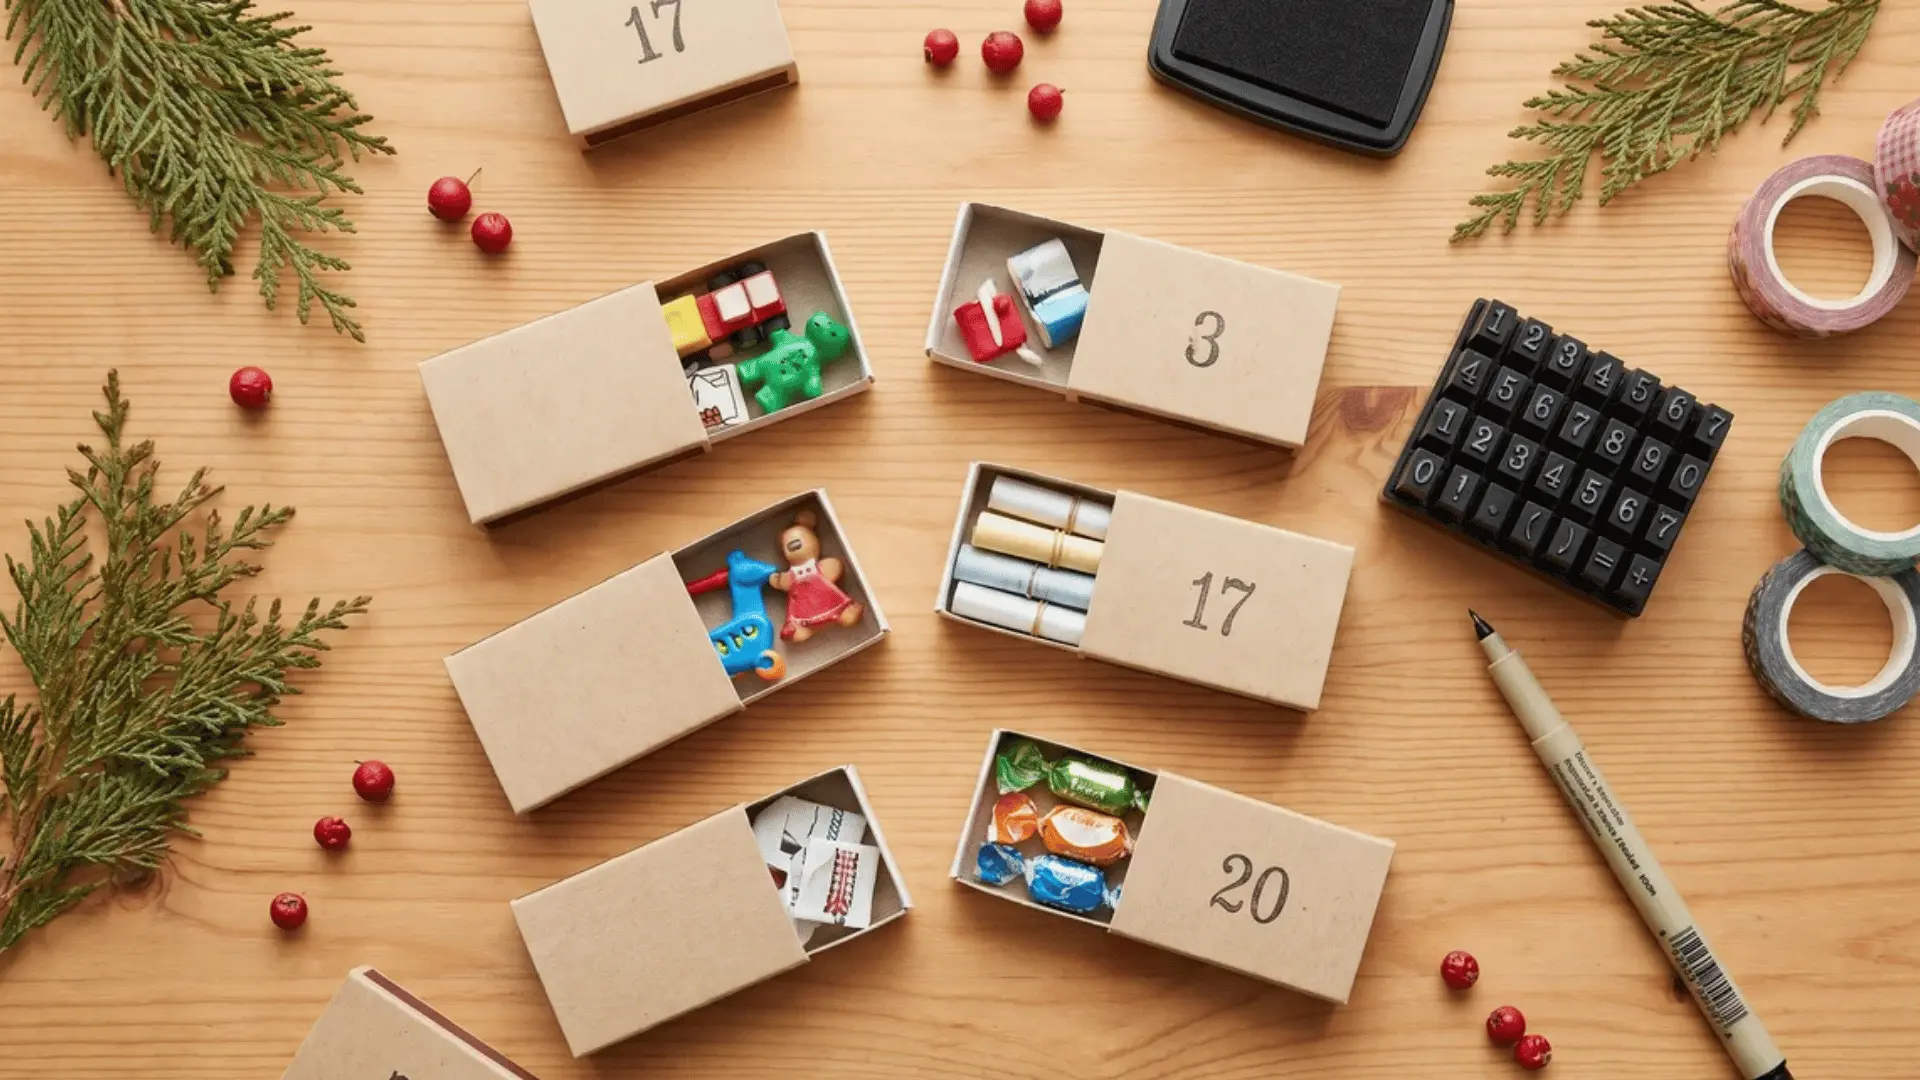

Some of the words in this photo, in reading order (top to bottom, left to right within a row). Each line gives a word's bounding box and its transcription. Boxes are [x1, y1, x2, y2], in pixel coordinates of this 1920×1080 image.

[625, 0, 685, 64] 17
[1185, 310, 1225, 368] 3
[1489, 308, 1506, 334] 1
[1522, 326, 1544, 351] 2
[1558, 341, 1578, 368] 3
[1594, 361, 1613, 388] 4
[1631, 377, 1652, 402] 5
[1668, 394, 1688, 420] 6
[1708, 411, 1727, 436] 7
[1461, 359, 1482, 385] 4
[1497, 375, 1519, 401] 5
[1535, 393, 1554, 419] 6
[1572, 411, 1591, 436] 7
[1605, 429, 1626, 454] 8
[1642, 446, 1661, 471] 9
[1680, 463, 1700, 488] 0
[1414, 458, 1435, 484] 0
[1437, 406, 1457, 434] 1
[1471, 425, 1493, 452] 2
[1508, 443, 1529, 470] 3
[1544, 463, 1565, 489] 4
[1581, 477, 1603, 504] 5
[1618, 496, 1639, 522] 6
[1658, 512, 1678, 538] 7
[1183, 571, 1256, 637] 17
[1209, 853, 1290, 925] 20
